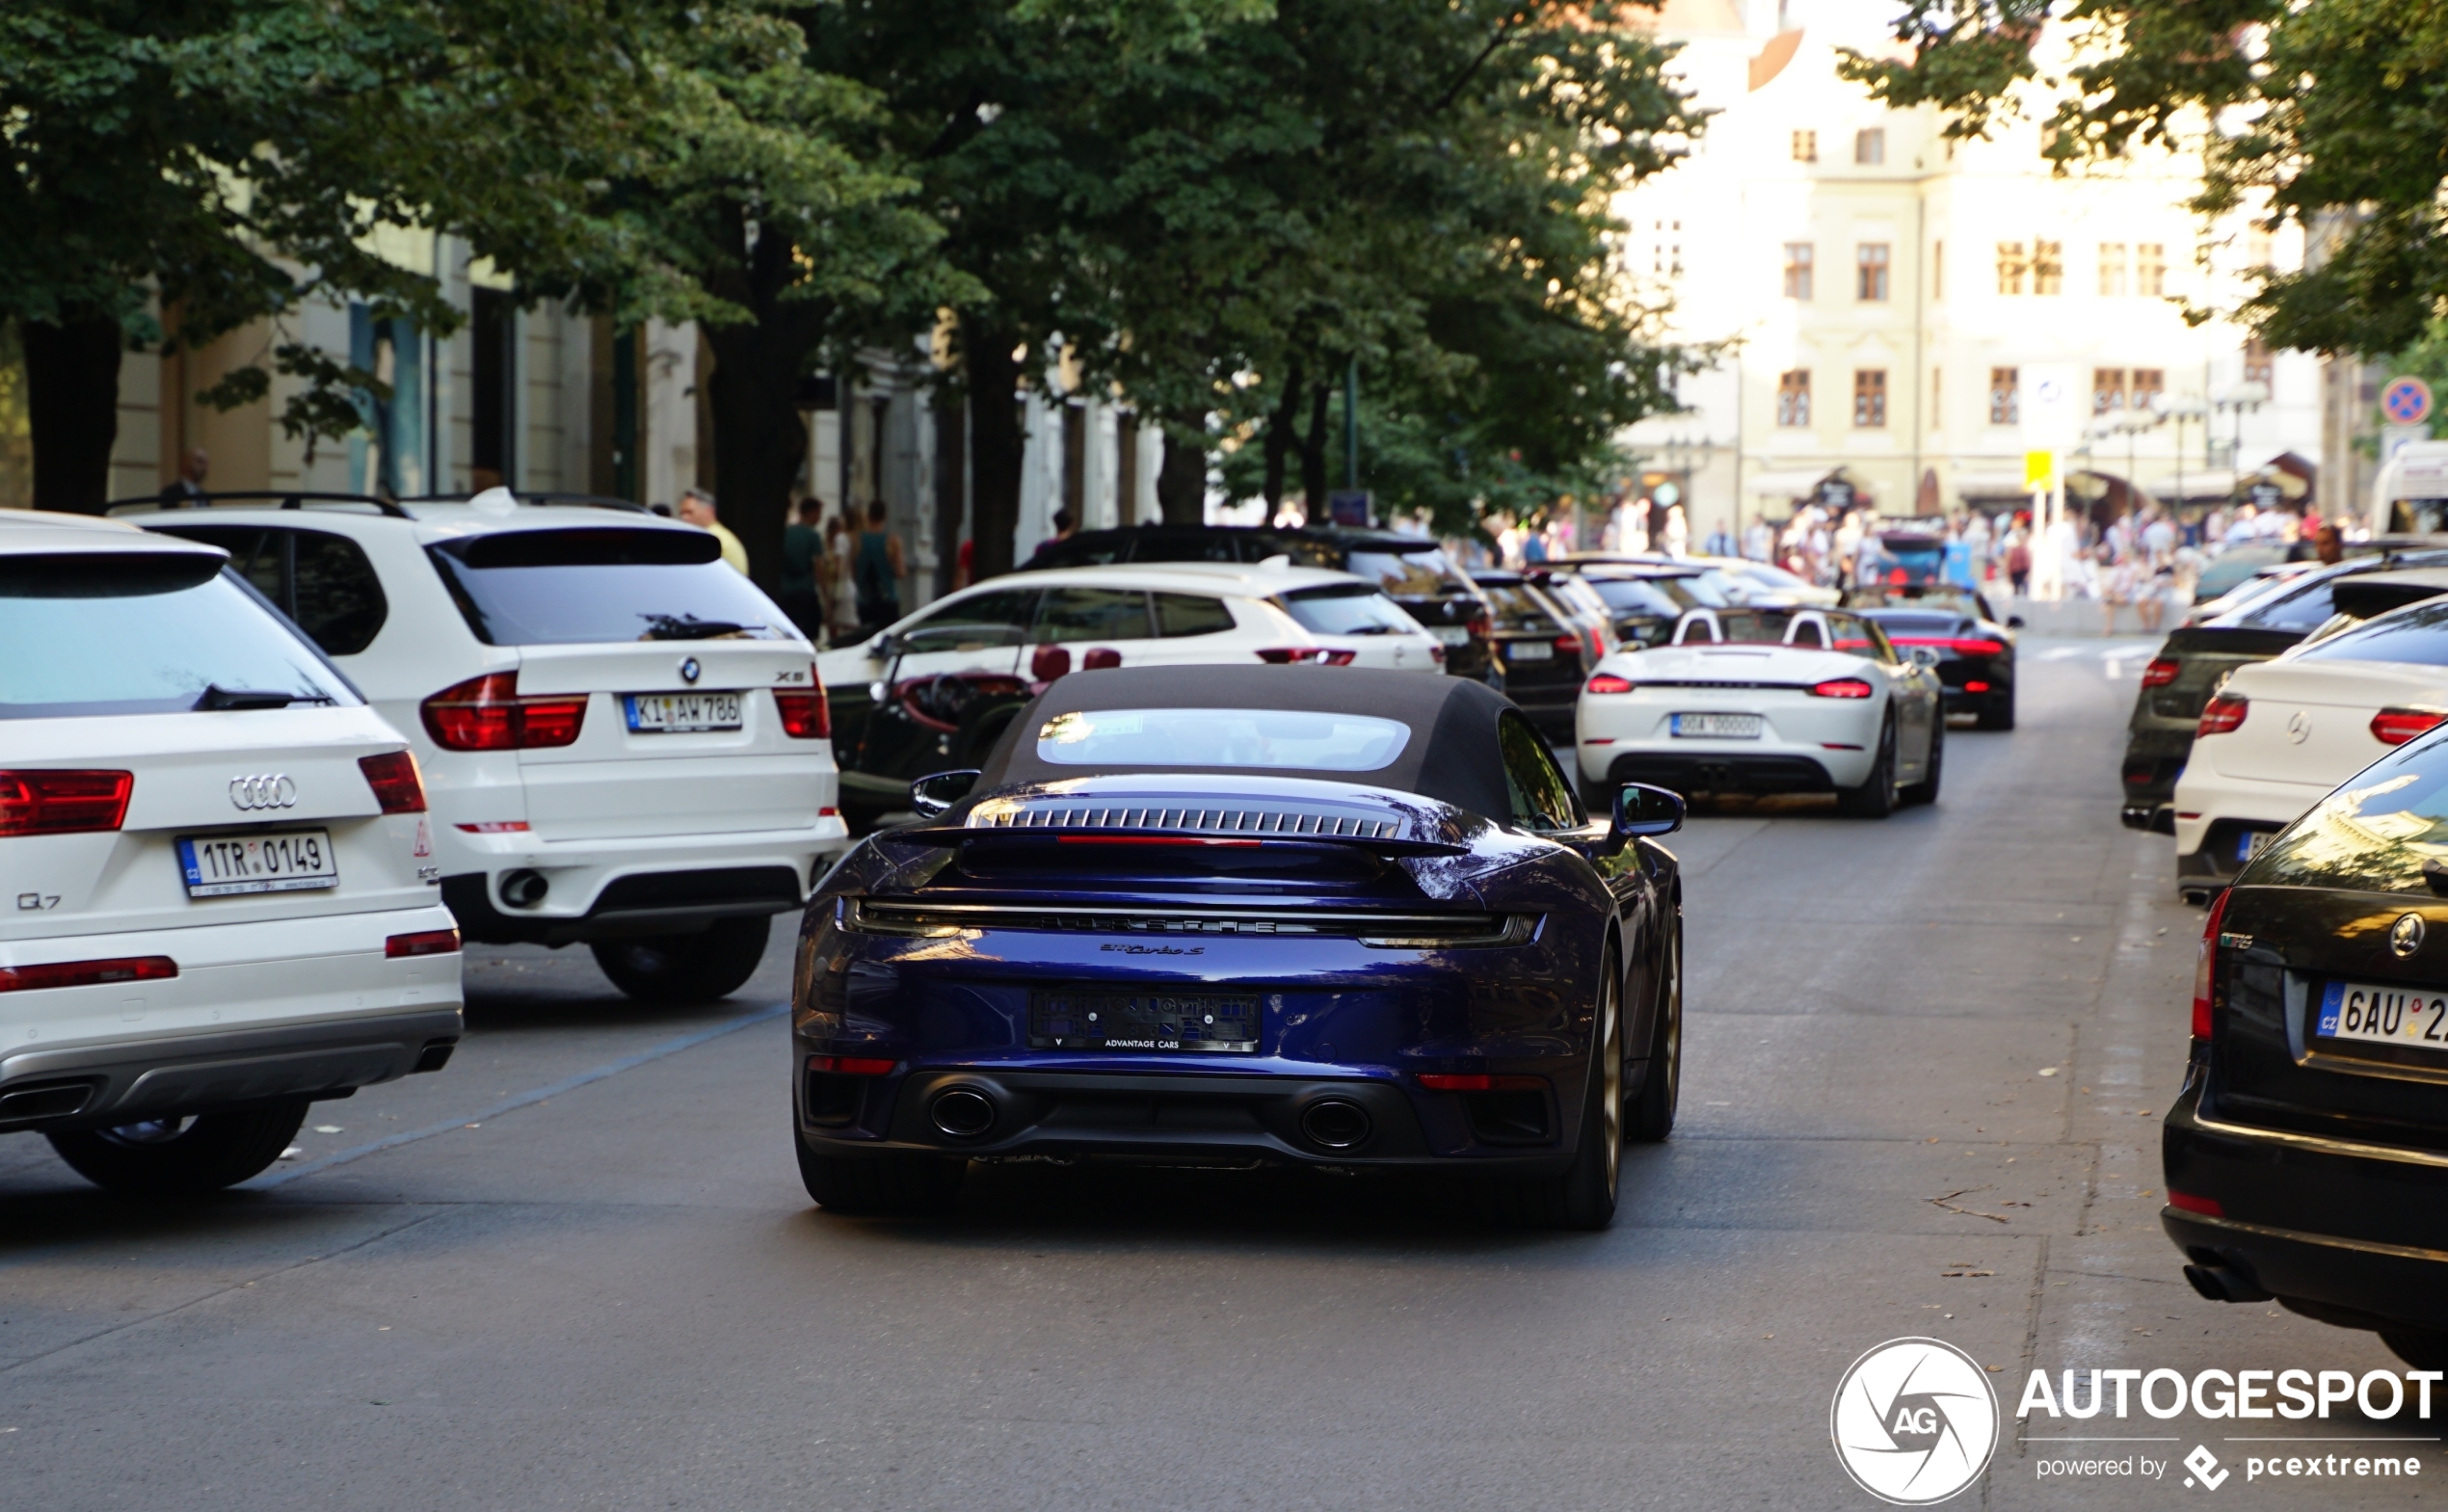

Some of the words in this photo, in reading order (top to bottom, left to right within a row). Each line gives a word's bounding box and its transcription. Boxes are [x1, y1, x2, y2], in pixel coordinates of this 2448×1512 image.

[639, 698, 663, 723] KI
[678, 698, 700, 722] AW
[704, 697, 737, 721] 786
[203, 842, 250, 878] 1TR
[262, 836, 323, 873] 0149
[17, 892, 62, 911] Q7
[2322, 1016, 2338, 1031] CZ
[2346, 991, 2405, 1037] 6AU
[2423, 998, 2448, 1044] 2
[1104, 1039, 1156, 1048] ADVANTAGE
[1157, 1041, 1180, 1049] CARS
